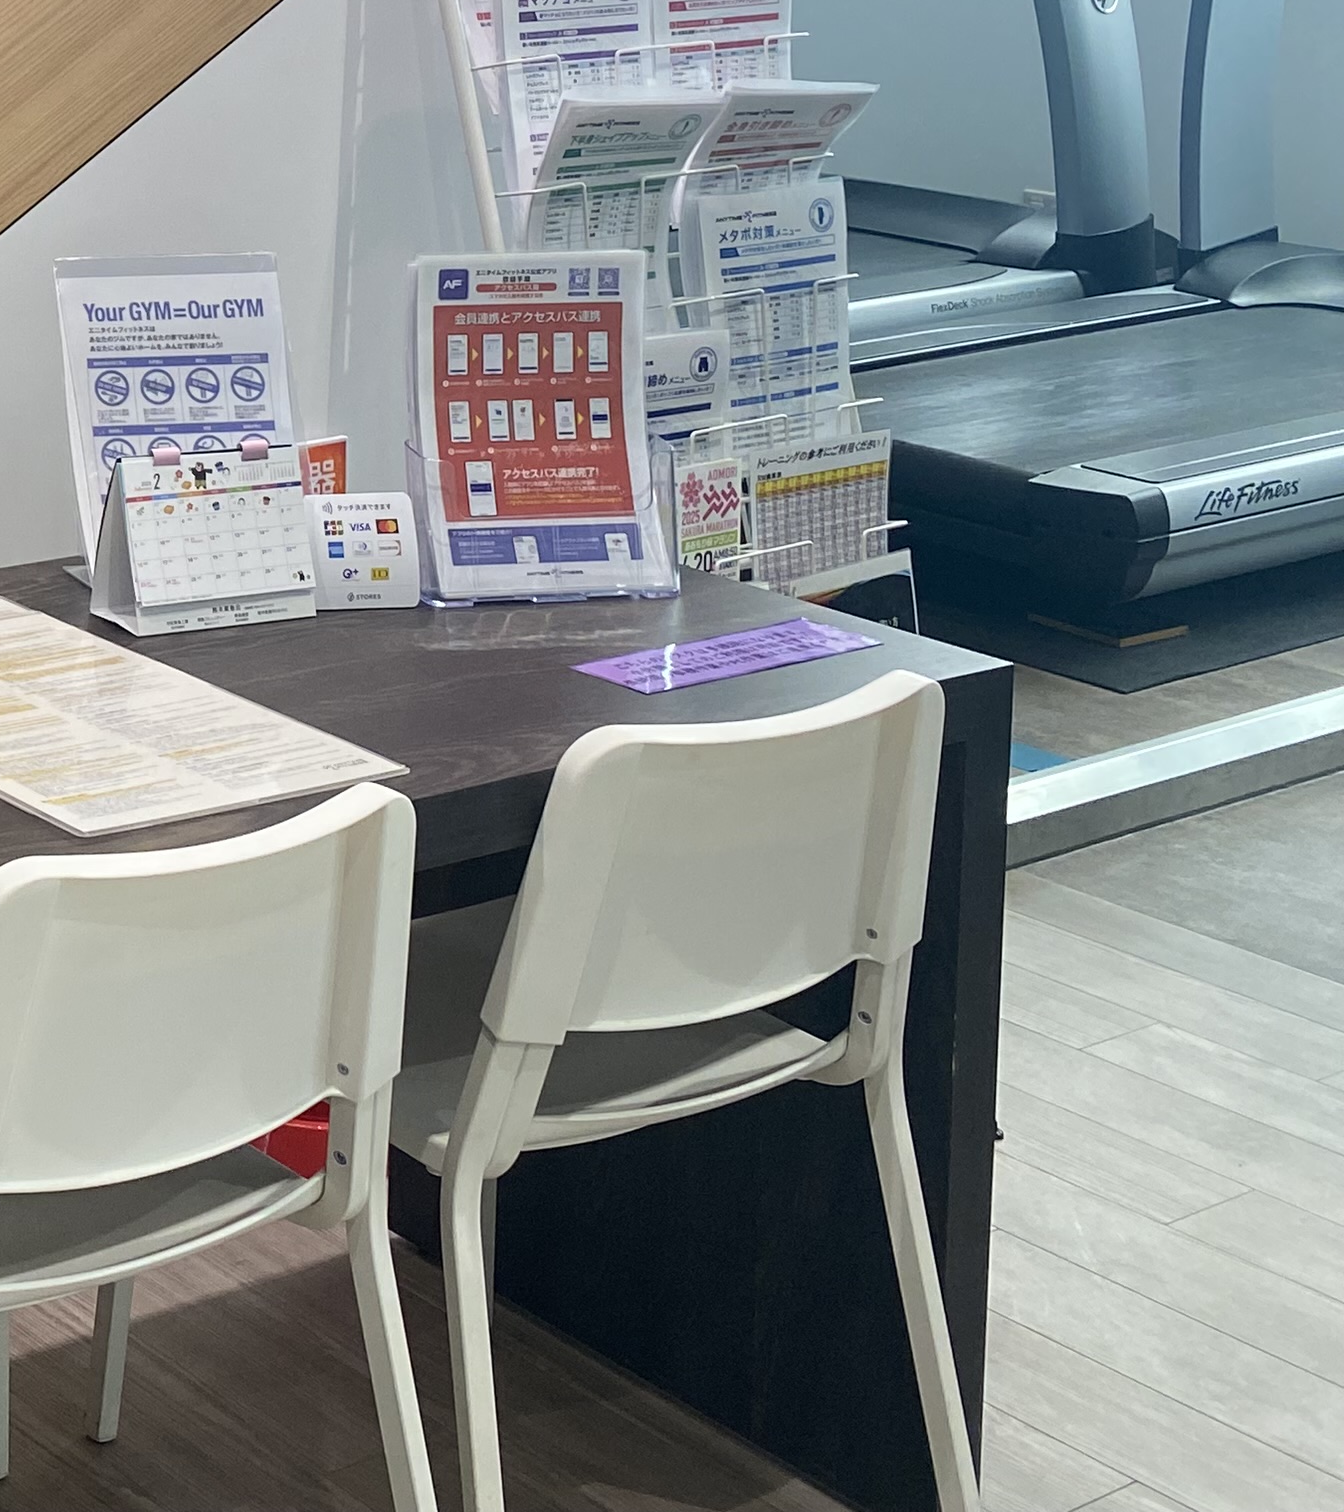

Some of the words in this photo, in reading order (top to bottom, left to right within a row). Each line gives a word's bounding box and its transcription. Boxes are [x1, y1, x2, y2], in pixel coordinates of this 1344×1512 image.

[442, 279, 463, 290] AF
[83, 302, 125, 322] Your
[222, 297, 265, 318] GYM
[454, 310, 601, 326] 会員連携とアクセスパス連携
[153, 473, 161, 490] 2
[681, 509, 701, 526] 2025
[348, 522, 372, 532] VISA
[355, 593, 382, 601] STORES
